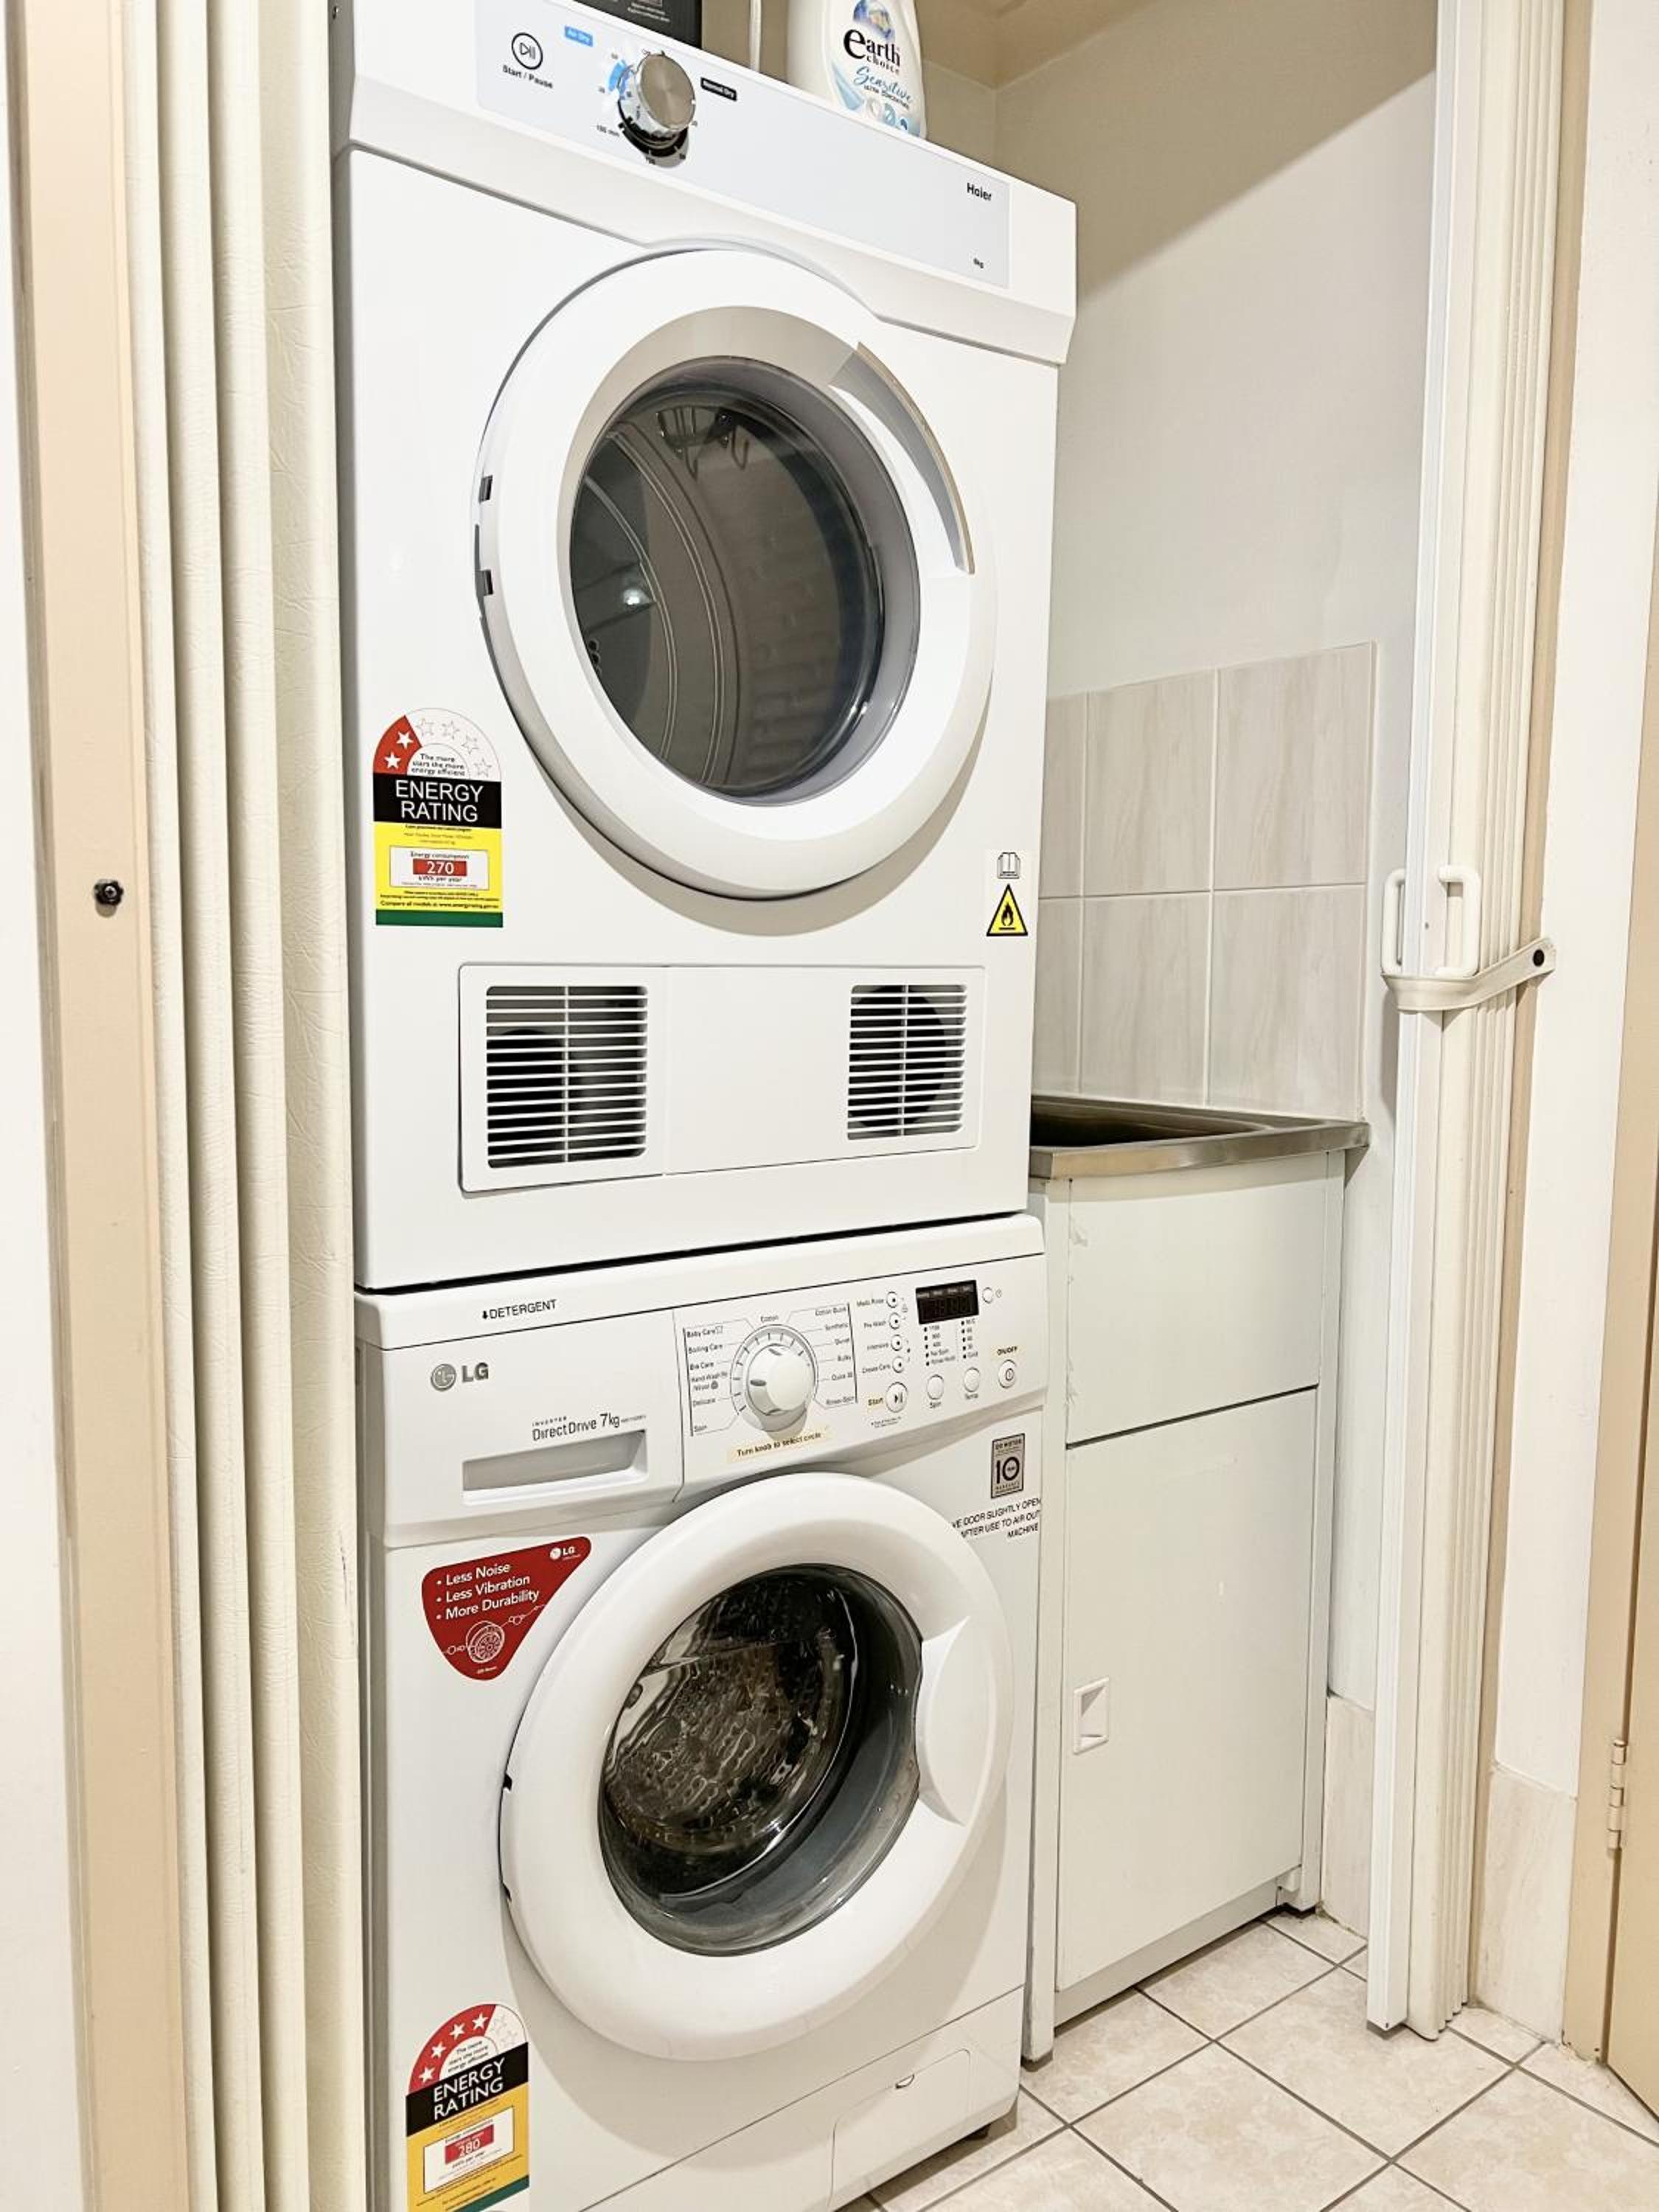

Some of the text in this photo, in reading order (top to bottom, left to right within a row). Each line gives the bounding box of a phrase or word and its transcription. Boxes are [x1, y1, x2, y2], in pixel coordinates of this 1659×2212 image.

[843, 29, 900, 67] earth
[503, 64, 522, 78] Start
[529, 73, 553, 88] Pause
[853, 66, 913, 102] Sensitive
[967, 182, 992, 201] Haier
[420, 753, 434, 761] The
[395, 779, 484, 803] ENERGY
[400, 800, 479, 823] RATING
[426, 860, 455, 875] 270
[490, 1299, 557, 1319] DETERGENT
[462, 1363, 489, 1382] LG
[868, 1397, 884, 1406] Start
[599, 1413, 620, 1428] 7kg
[737, 1447, 754, 1457] Turn
[755, 1442, 773, 1453] knob
[773, 1440, 782, 1448] to
[782, 1435, 803, 1446] select
[996, 1456, 1020, 1484] 10
[963, 1512, 986, 1526] DOOR
[986, 1503, 1021, 1520] SLIGHTLY
[984, 1521, 1001, 1533] USE
[1001, 1518, 1012, 1527] TO
[1012, 1514, 1026, 1525] AIR
[1007, 1523, 1039, 1538] MACHINE
[563, 1545, 575, 1556] LG
[445, 1563, 512, 1586] Less Noise
[445, 1576, 531, 1604] Less Vibration
[445, 1589, 540, 1620] More Durability
[434, 2057, 505, 2103] ENERGY
[434, 2076, 504, 2121] RATING
[457, 2138, 481, 2157] 280
